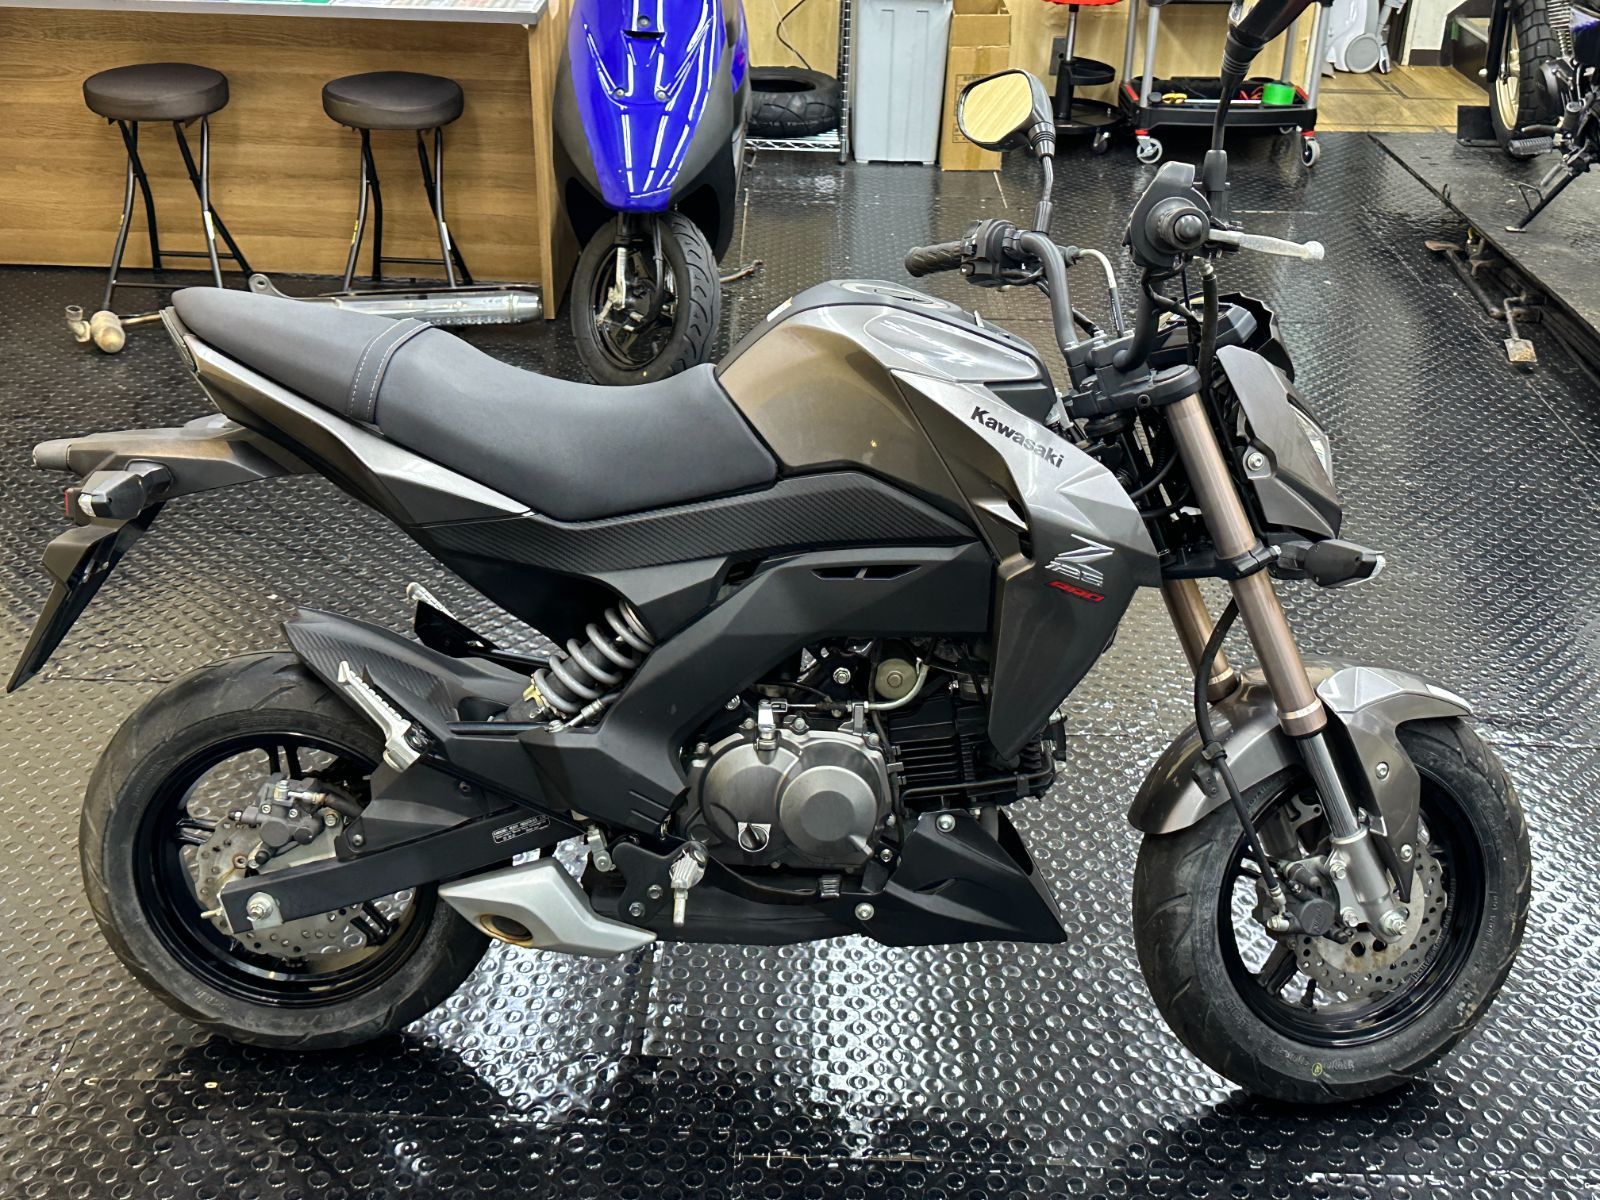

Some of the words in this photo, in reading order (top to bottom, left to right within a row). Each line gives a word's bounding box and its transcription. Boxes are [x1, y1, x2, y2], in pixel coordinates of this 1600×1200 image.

[970, 405, 1065, 469] Kawasaki
[1054, 533, 1115, 564] Z
[1046, 581, 1105, 602] PRO
